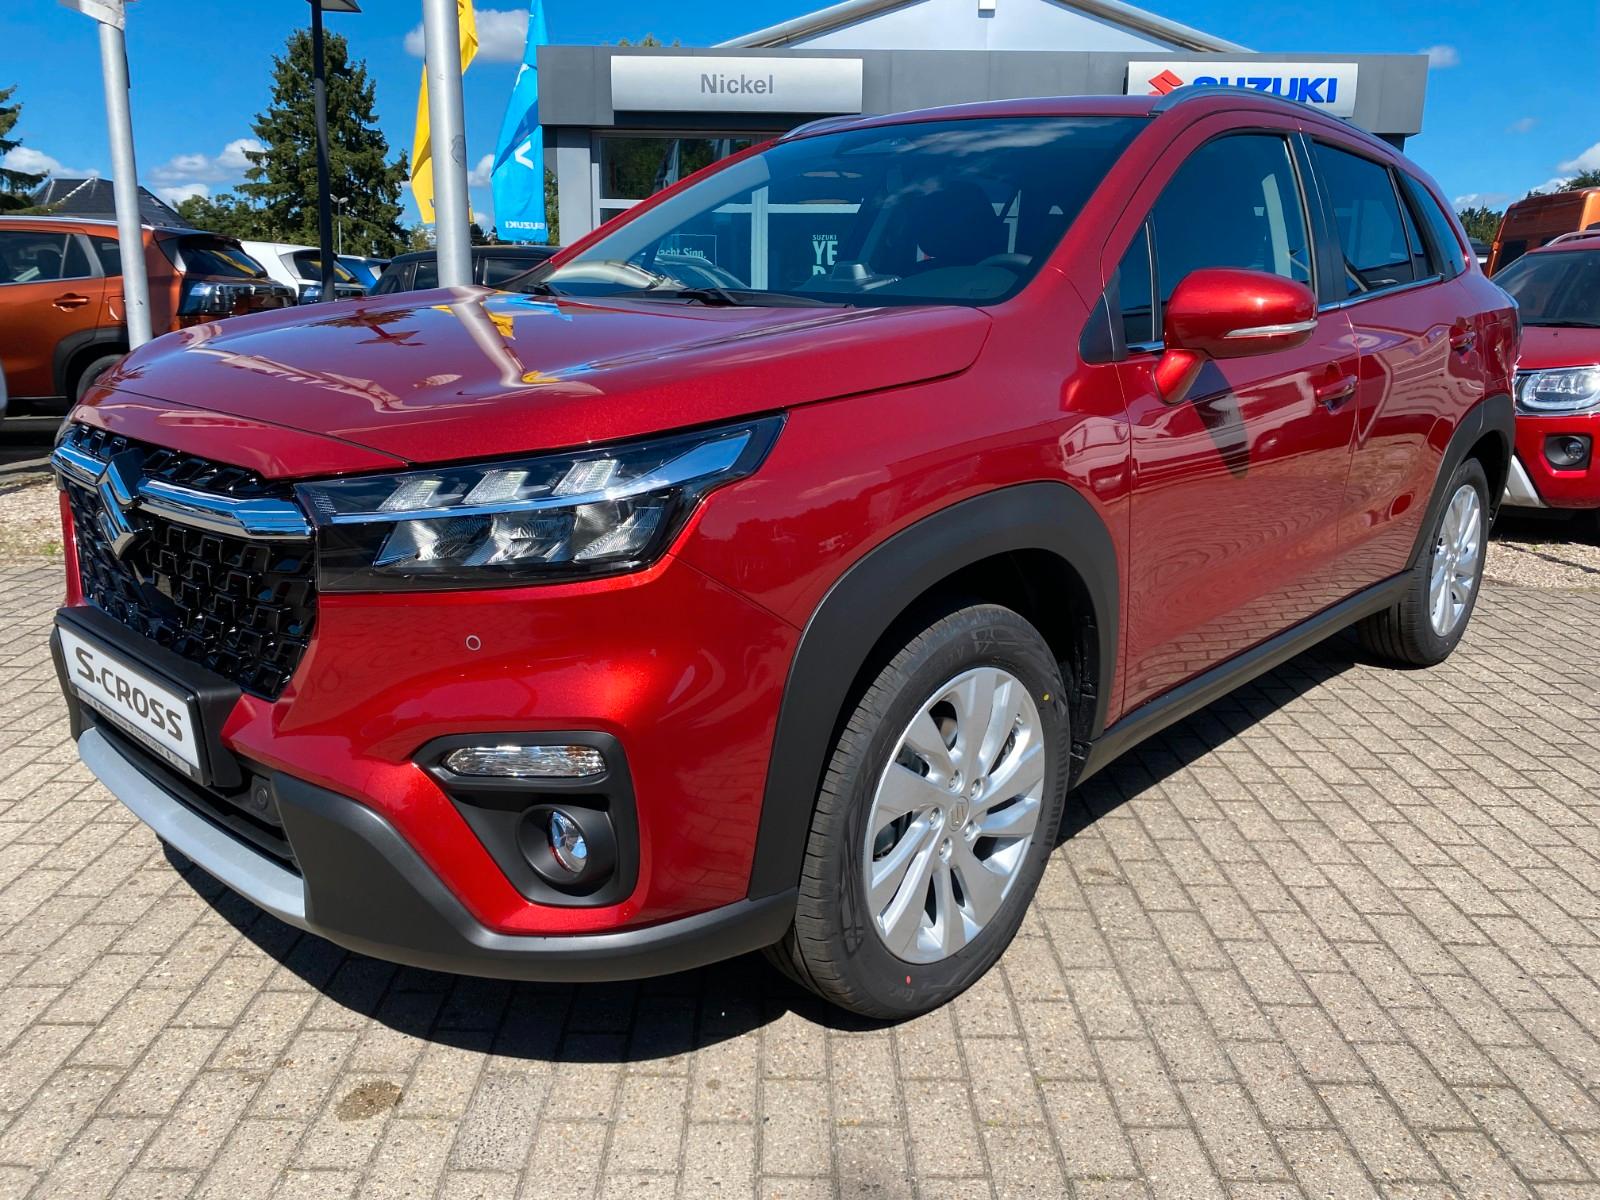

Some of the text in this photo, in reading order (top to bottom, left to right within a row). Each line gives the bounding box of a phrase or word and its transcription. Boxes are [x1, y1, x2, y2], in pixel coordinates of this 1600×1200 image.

[701, 73, 774, 94] Nickel
[812, 233, 838, 241] SUZUKI
[656, 247, 680, 257] acht
